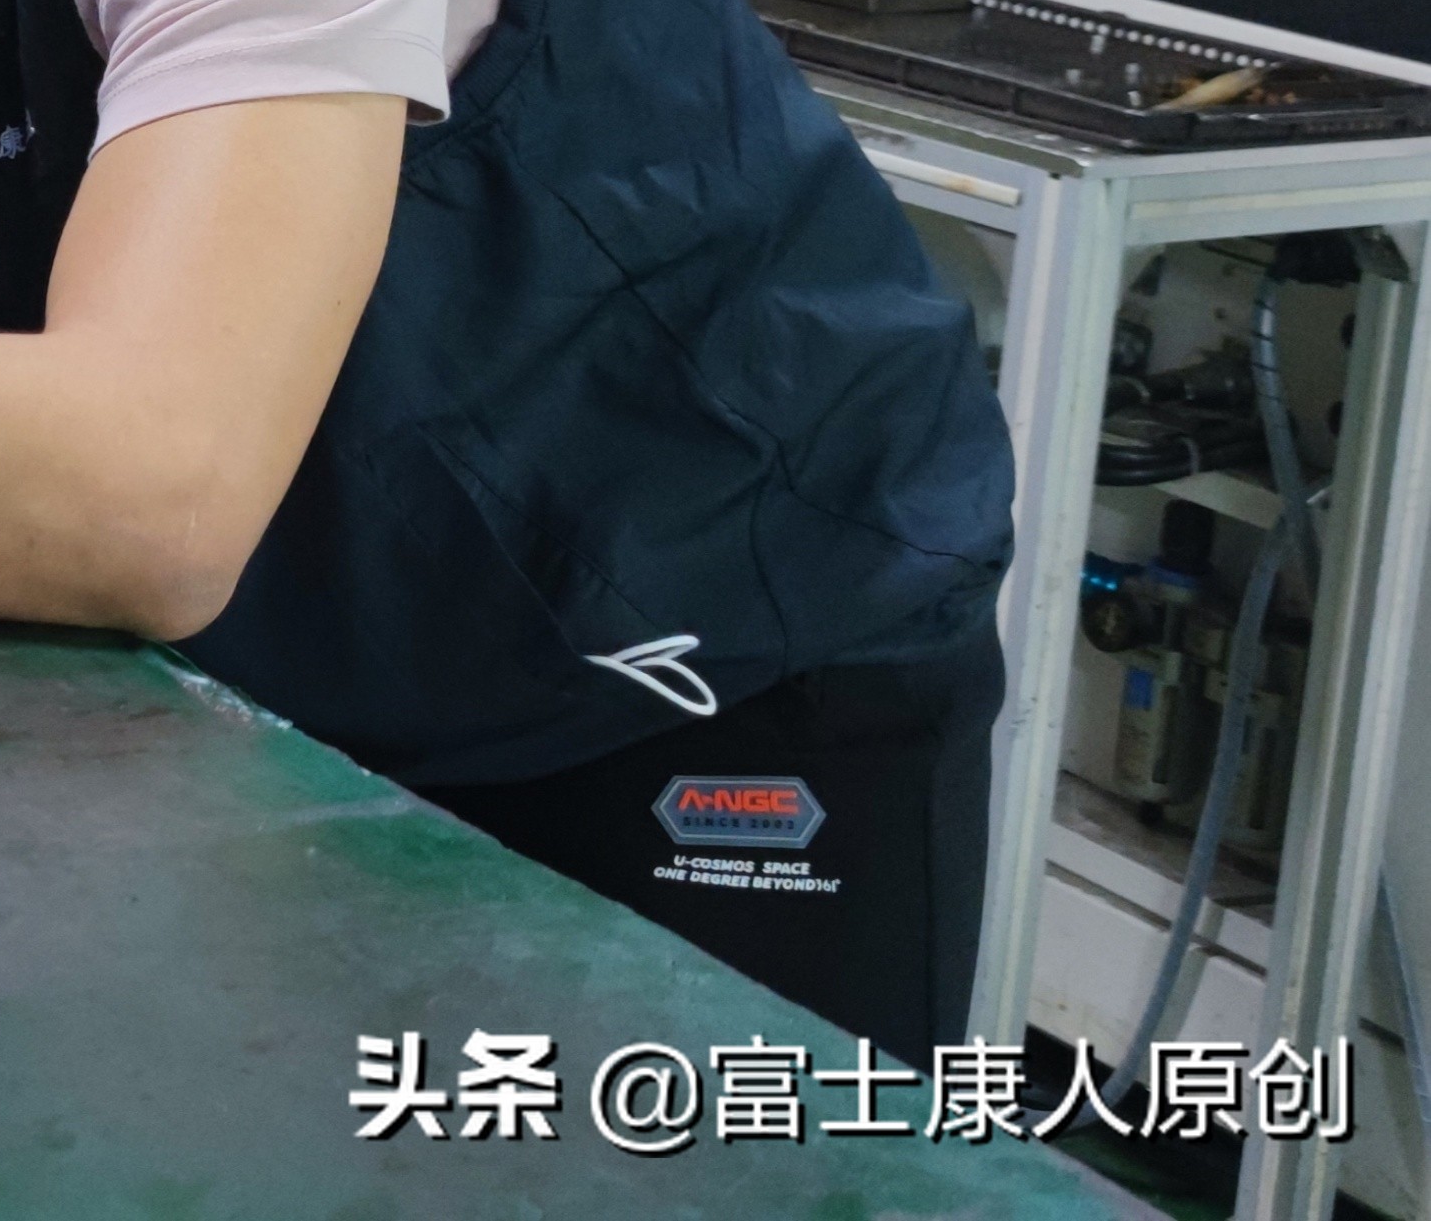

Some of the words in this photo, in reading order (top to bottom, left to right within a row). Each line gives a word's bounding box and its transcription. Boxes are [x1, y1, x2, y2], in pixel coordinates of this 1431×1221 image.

[682, 816, 741, 828] SINCE
[673, 854, 756, 873] U-COSMOS
[761, 861, 811, 876] SPACE
[652, 865, 688, 881] ONE
[689, 870, 751, 888] DEGREE
